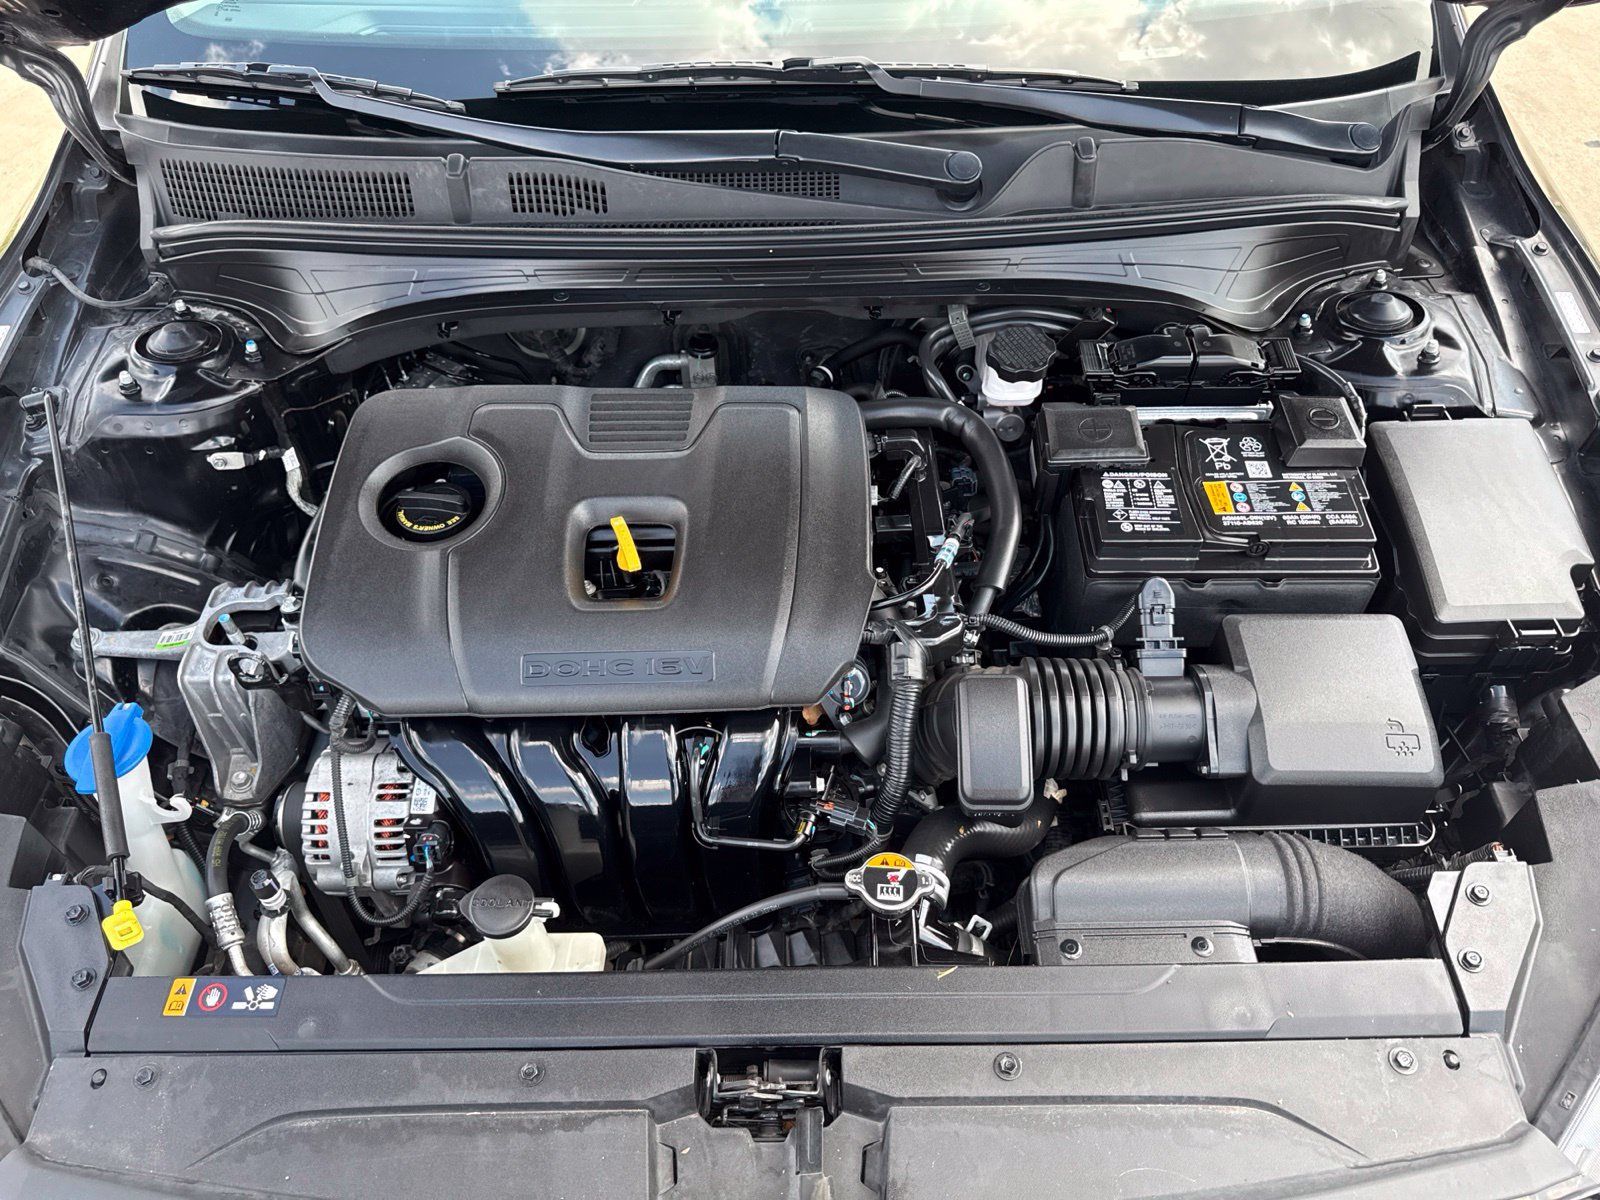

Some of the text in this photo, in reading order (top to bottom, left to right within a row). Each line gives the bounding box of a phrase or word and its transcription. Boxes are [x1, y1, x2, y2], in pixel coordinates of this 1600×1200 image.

[1215, 462, 1231, 470] Pb
[412, 523, 446, 531] OWNER'S
[524, 656, 710, 678] DOHC 16V
[471, 897, 531, 909] COOLANT
